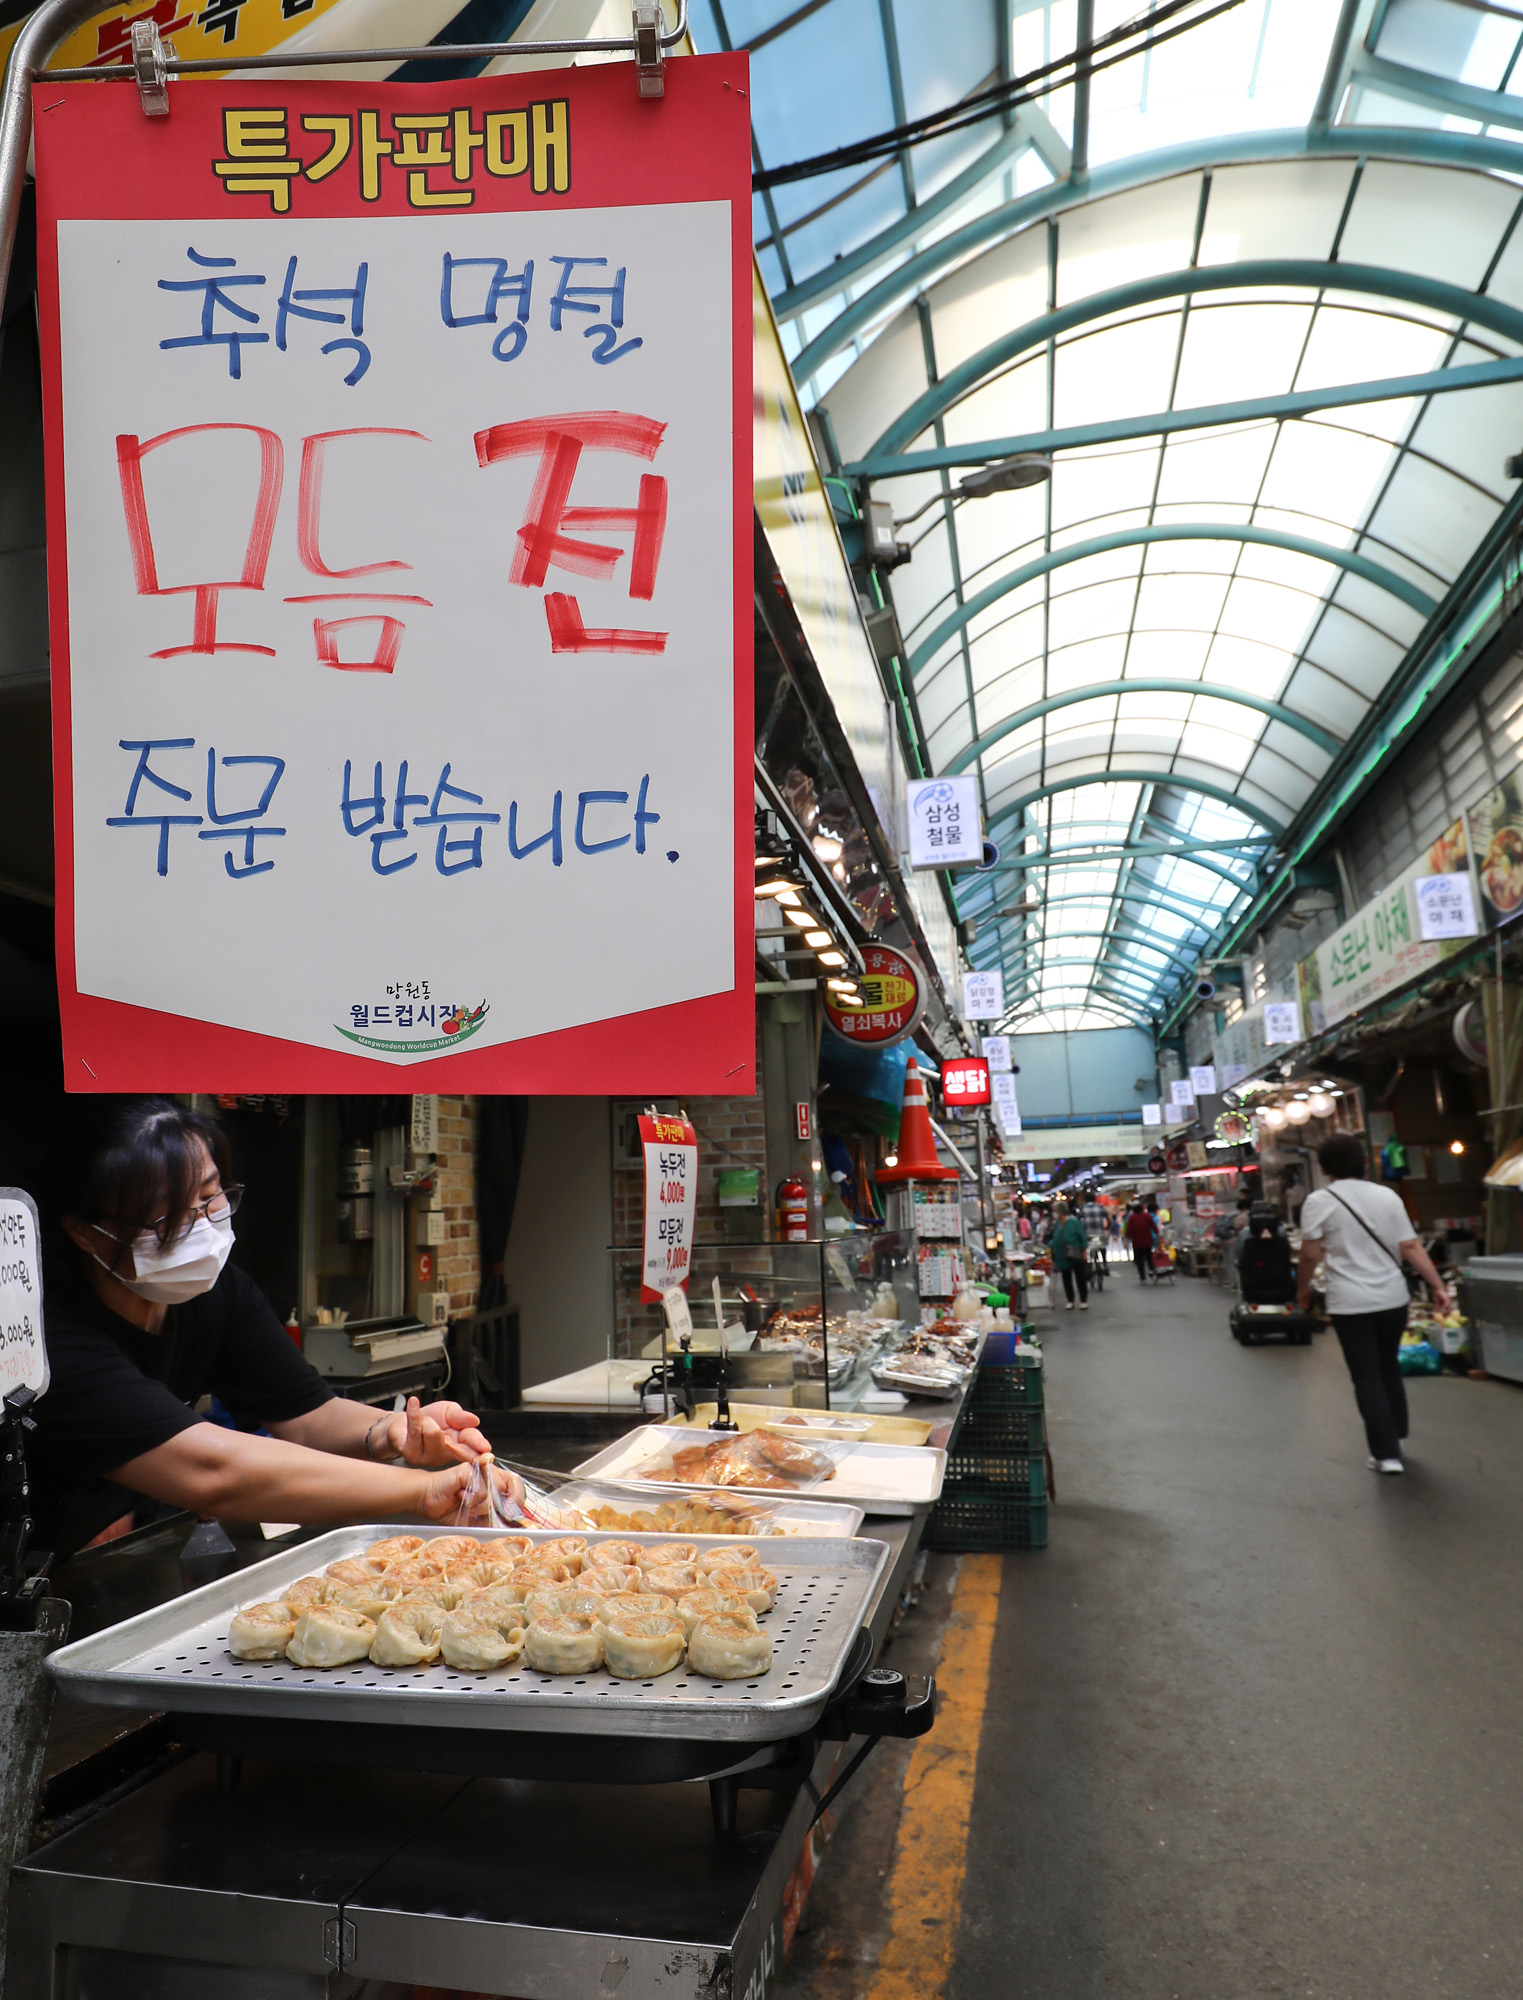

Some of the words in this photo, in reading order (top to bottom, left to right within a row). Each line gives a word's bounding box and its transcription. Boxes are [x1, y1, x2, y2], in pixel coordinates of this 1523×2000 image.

[211, 97, 573, 215] 특가판매
[157, 246, 372, 387] 추석
[440, 251, 645, 366] 명절
[115, 422, 433, 673] 모듬
[474, 409, 669, 656] 전
[106, 738, 287, 879] 주문
[340, 758, 680, 877] 받습니다.
[925, 802, 960, 824] 삼성
[927, 825, 963, 847] 철물
[1329, 918, 1372, 988] 소문난
[386, 981, 431, 1000] 망원동
[841, 1012, 903, 1032] 열쇠복사
[357, 1036, 406, 1051] Mangwondong
[407, 1041, 438, 1050] Worldcup
[438, 1035, 461, 1047] Market
[945, 1069, 987, 1094] 생닭
[656, 1122, 685, 1142] 특가판매
[660, 1152, 686, 1179] 녹두전
[660, 1182, 685, 1208] 4,000원
[658, 1218, 684, 1246] 모듬전
